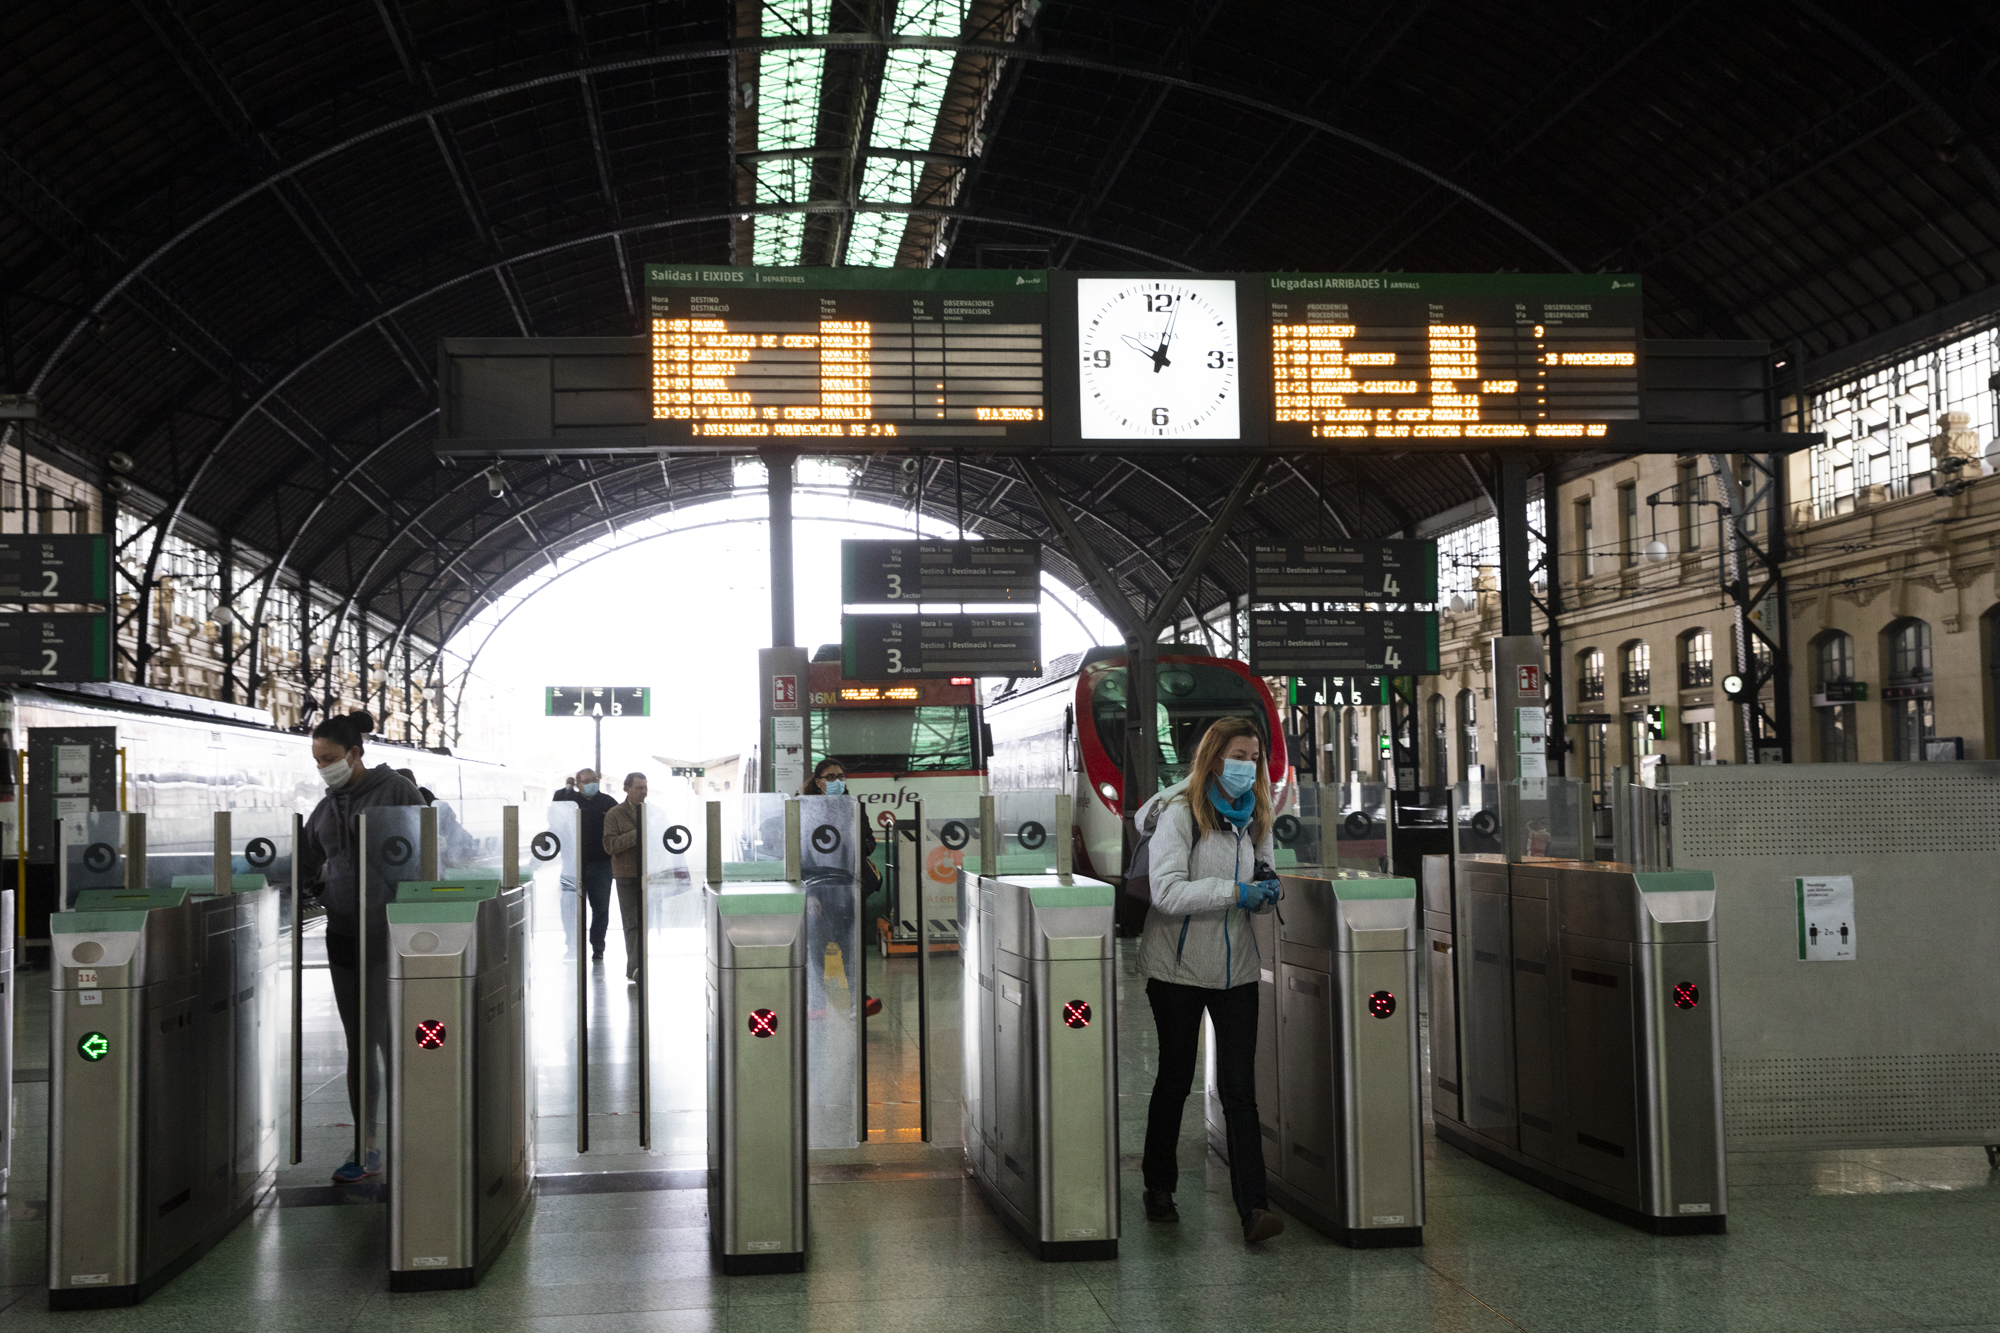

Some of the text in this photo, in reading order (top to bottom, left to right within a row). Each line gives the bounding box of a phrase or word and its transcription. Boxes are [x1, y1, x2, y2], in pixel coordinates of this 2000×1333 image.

[652, 270, 692, 282] Salidas
[703, 271, 744, 282] EIXIDES
[1271, 278, 1318, 290] Llegadas
[1325, 279, 1380, 289] ARRIBADES
[691, 304, 729, 312] DESTINACIÓ
[1143, 294, 1172, 312] 12
[1093, 350, 1111, 368] 9
[1207, 351, 1224, 369] 3
[1152, 407, 1169, 426] 6
[42, 571, 59, 597] 2
[887, 574, 902, 598] 3
[1382, 574, 1400, 597] 4
[42, 649, 58, 675] 2
[887, 649, 902, 673] 3
[1385, 646, 1402, 669] 4
[1314, 692, 1362, 705] 4 A 5
[573, 702, 622, 716] 2 A 3
[79, 974, 97, 982] 116
